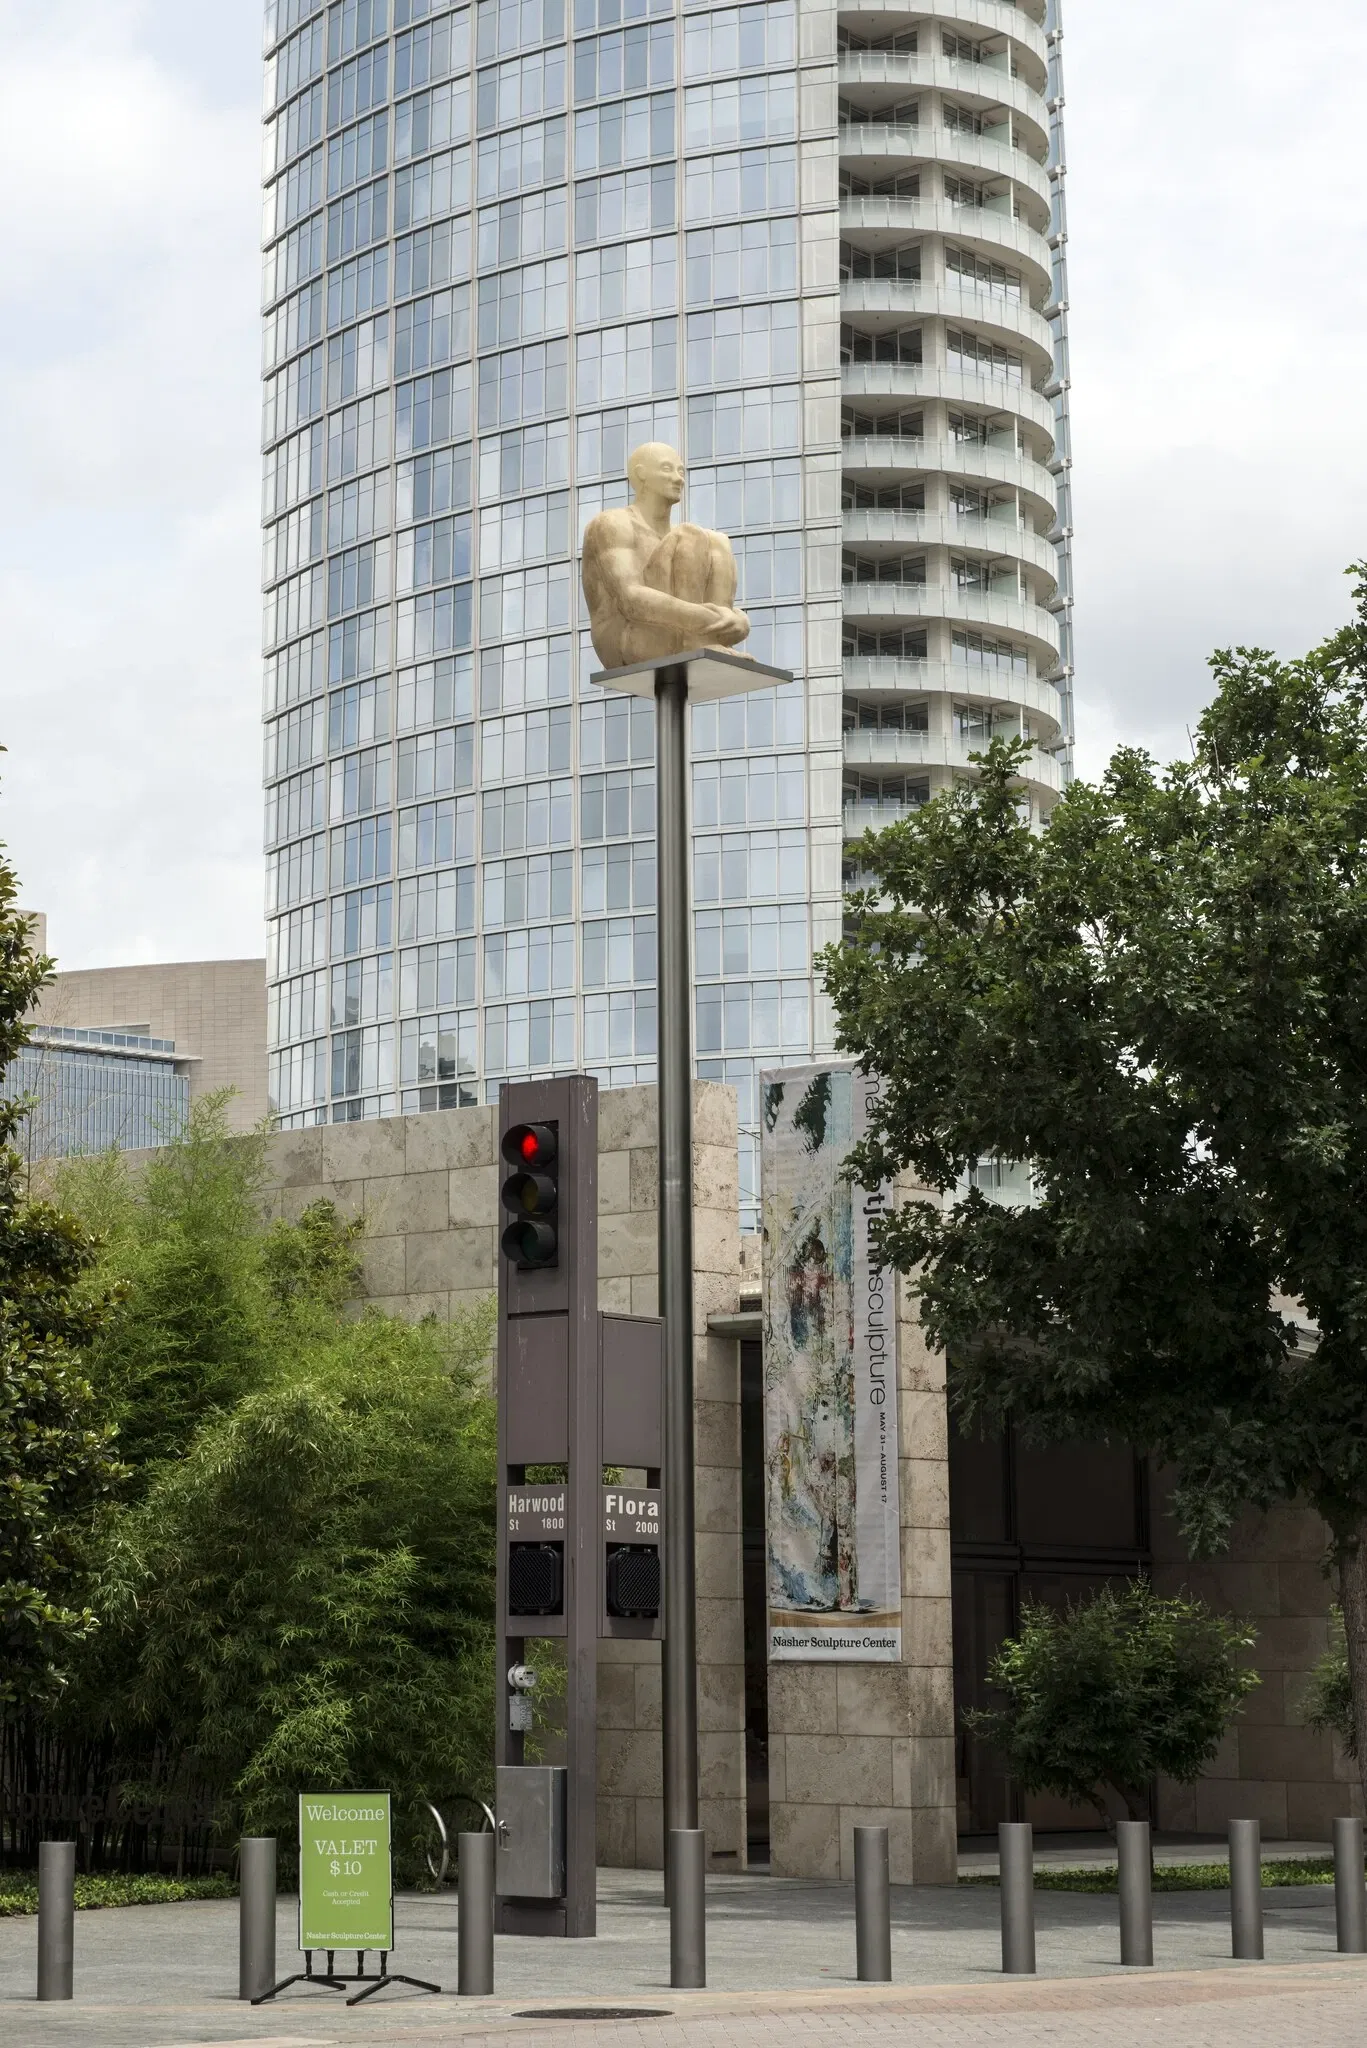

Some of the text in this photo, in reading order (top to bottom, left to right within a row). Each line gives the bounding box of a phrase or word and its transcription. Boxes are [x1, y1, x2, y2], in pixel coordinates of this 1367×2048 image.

[509, 1493, 565, 1513] Harwood
[606, 1495, 659, 1517] Flora
[509, 1518, 565, 1530] St 1800
[606, 1519, 659, 1534] St 2000
[773, 1637, 896, 1650] Nasher Sculpture Center
[306, 1805, 385, 1821] Welcome
[314, 1840, 377, 1855] VALET
[349, 1889, 369, 1897] Credit
[306, 1932, 387, 1941] Nasher Sculpture Center
